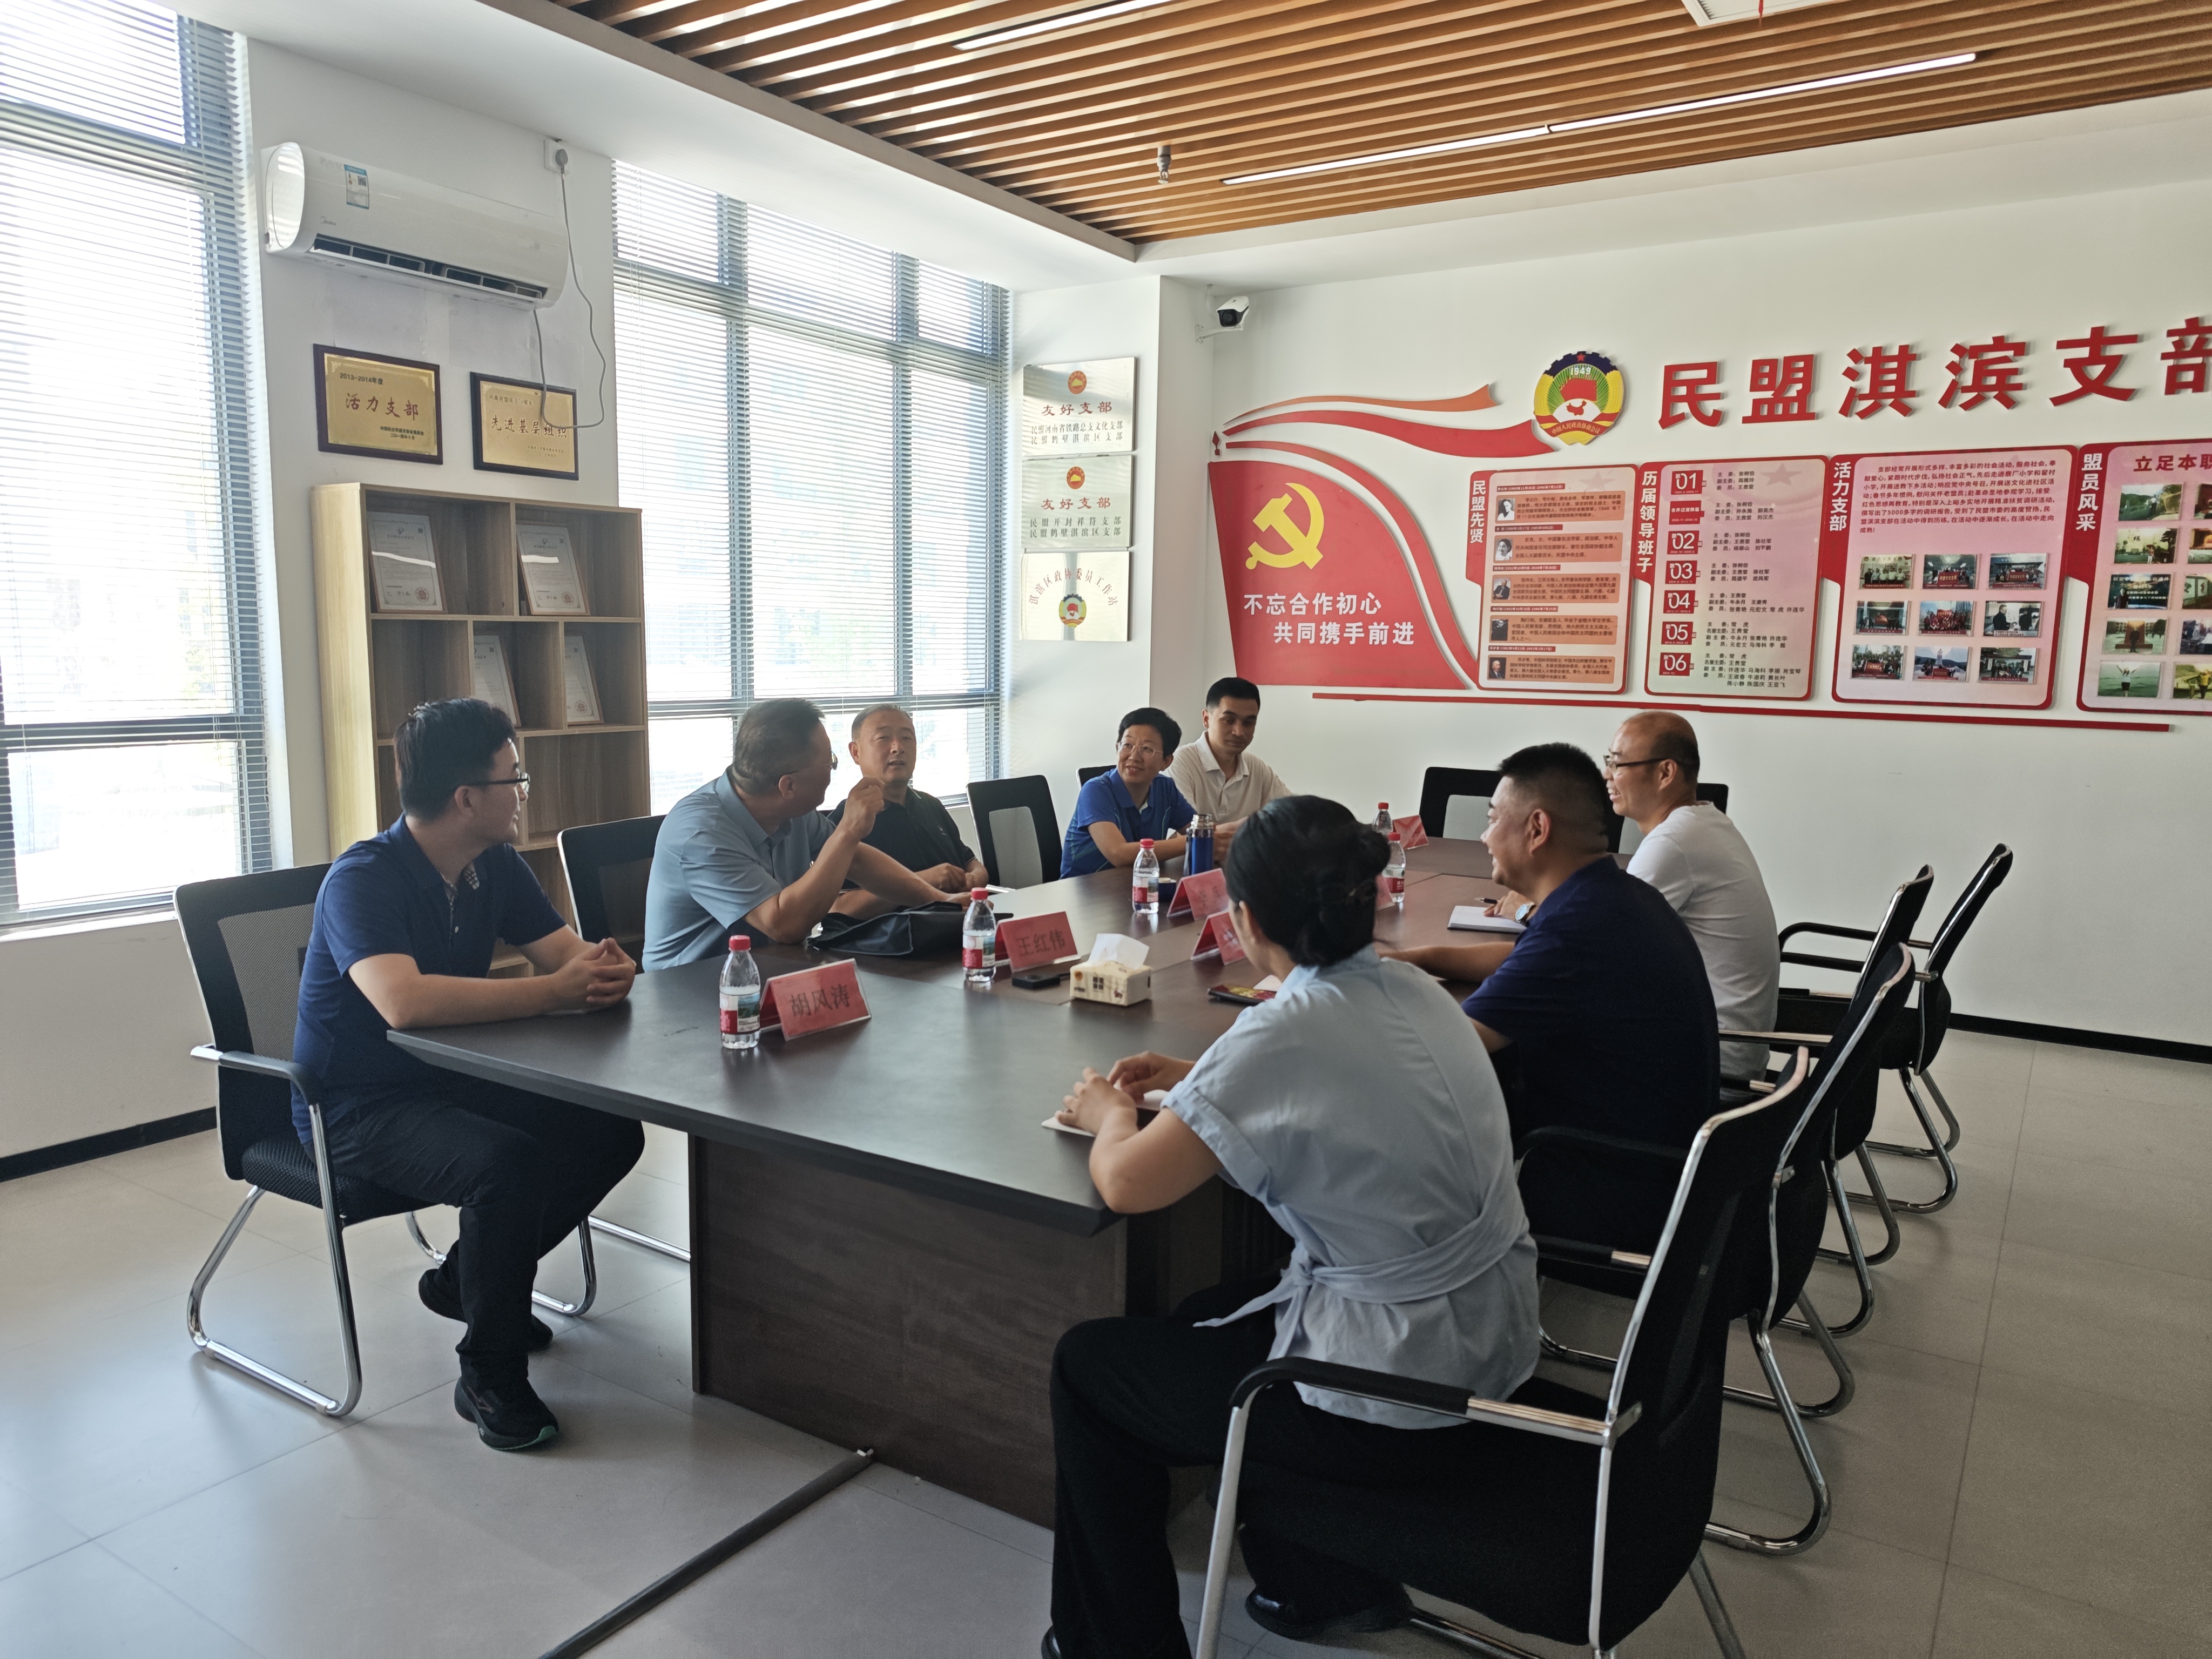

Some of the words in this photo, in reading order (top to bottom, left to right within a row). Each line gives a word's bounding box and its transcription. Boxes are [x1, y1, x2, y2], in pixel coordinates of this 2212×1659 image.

[340, 373, 383, 385] 2013-2014年度
[1658, 316, 2212, 430] 民盟淇滨支部
[346, 392, 419, 421] 活力支部
[1041, 401, 1112, 416] 友好支部
[491, 414, 567, 438] 先进基层组织
[1031, 421, 1123, 435] 民盟河南省铁路总支文化支部
[1551, 421, 1601, 435] 中国人民政治协商会议
[1031, 431, 1123, 445] 民盟鹤壁淇滨区支部
[2133, 454, 2212, 472] 立足本职
[1041, 497, 1111, 510] 友好支部
[1829, 462, 1852, 531] 活力支部
[2075, 453, 2103, 531] 盟员风采
[1030, 516, 1121, 528] 民盟开封祥符支部
[1469, 480, 1487, 544] 民盟先贤
[1637, 471, 1658, 572] 历届领导班子
[1030, 527, 1121, 538] 民盟鹤壁淇滨区支部
[1029, 568, 1118, 606] 淇滨区政协委员工作站
[1244, 592, 1381, 615] 不忘合作初心
[1273, 621, 1414, 645] 共同携手前进
[1016, 928, 1066, 956] 王红伟
